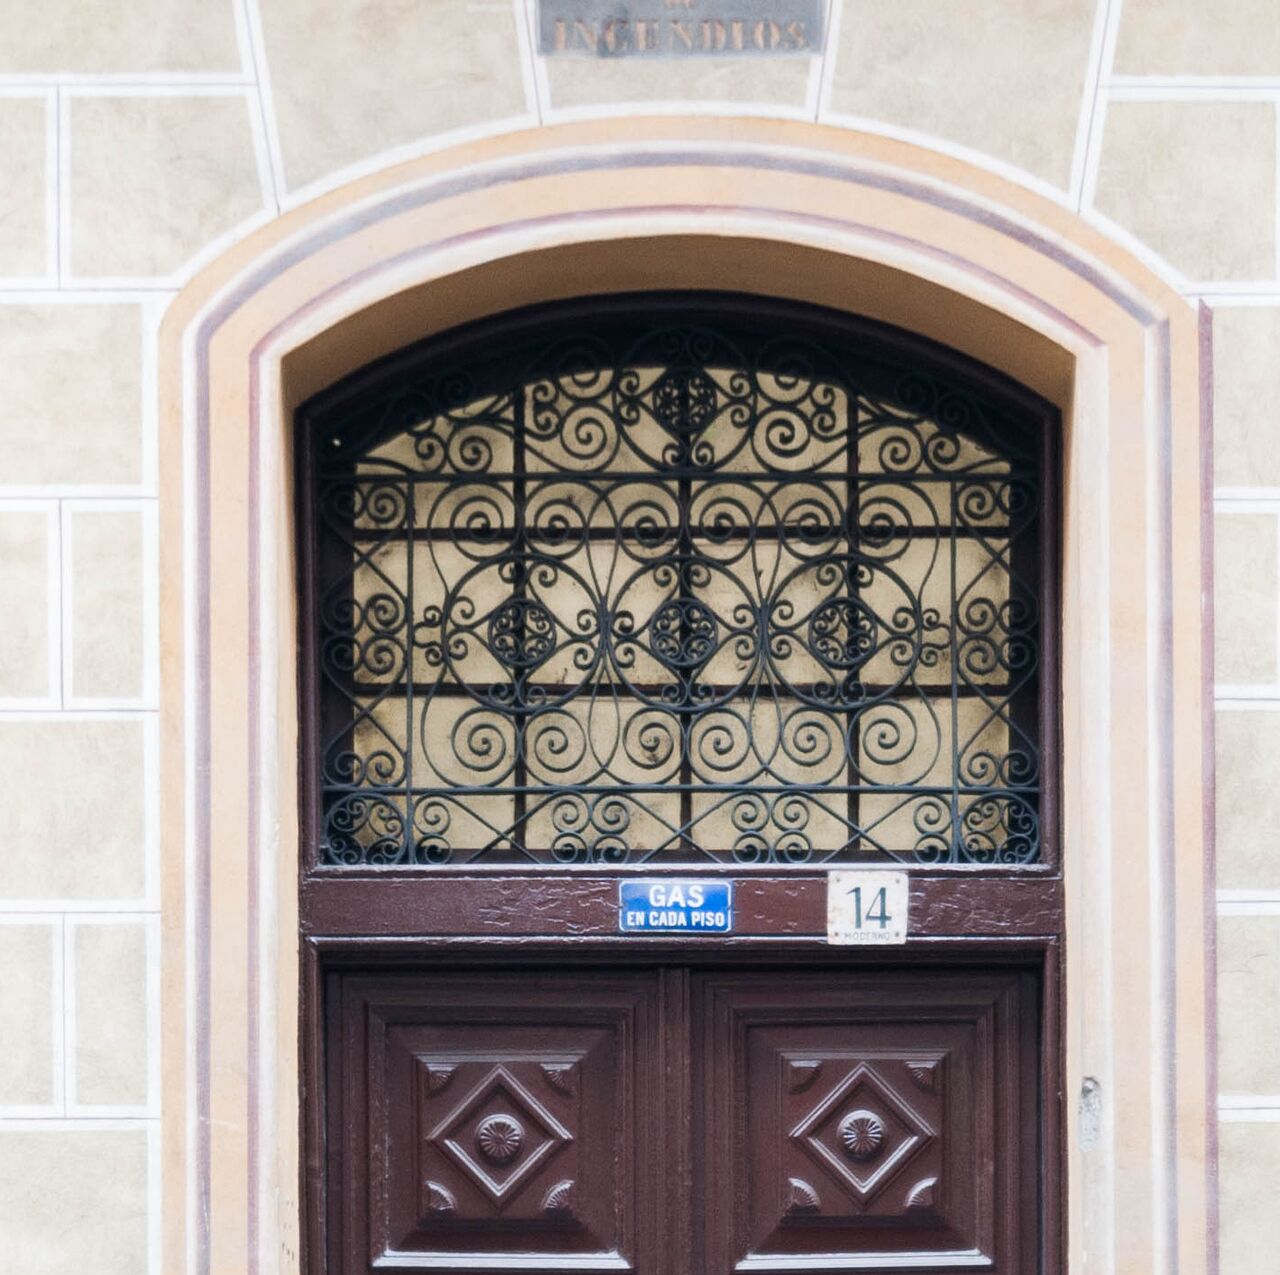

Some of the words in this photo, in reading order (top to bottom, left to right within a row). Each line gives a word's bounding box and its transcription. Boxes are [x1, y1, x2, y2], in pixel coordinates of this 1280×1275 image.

[649, 884, 705, 908] GAS
[846, 886, 892, 929] 14
[627, 911, 645, 926] EN
[649, 911, 687, 927] CADA
[691, 911, 725, 927] PISO
